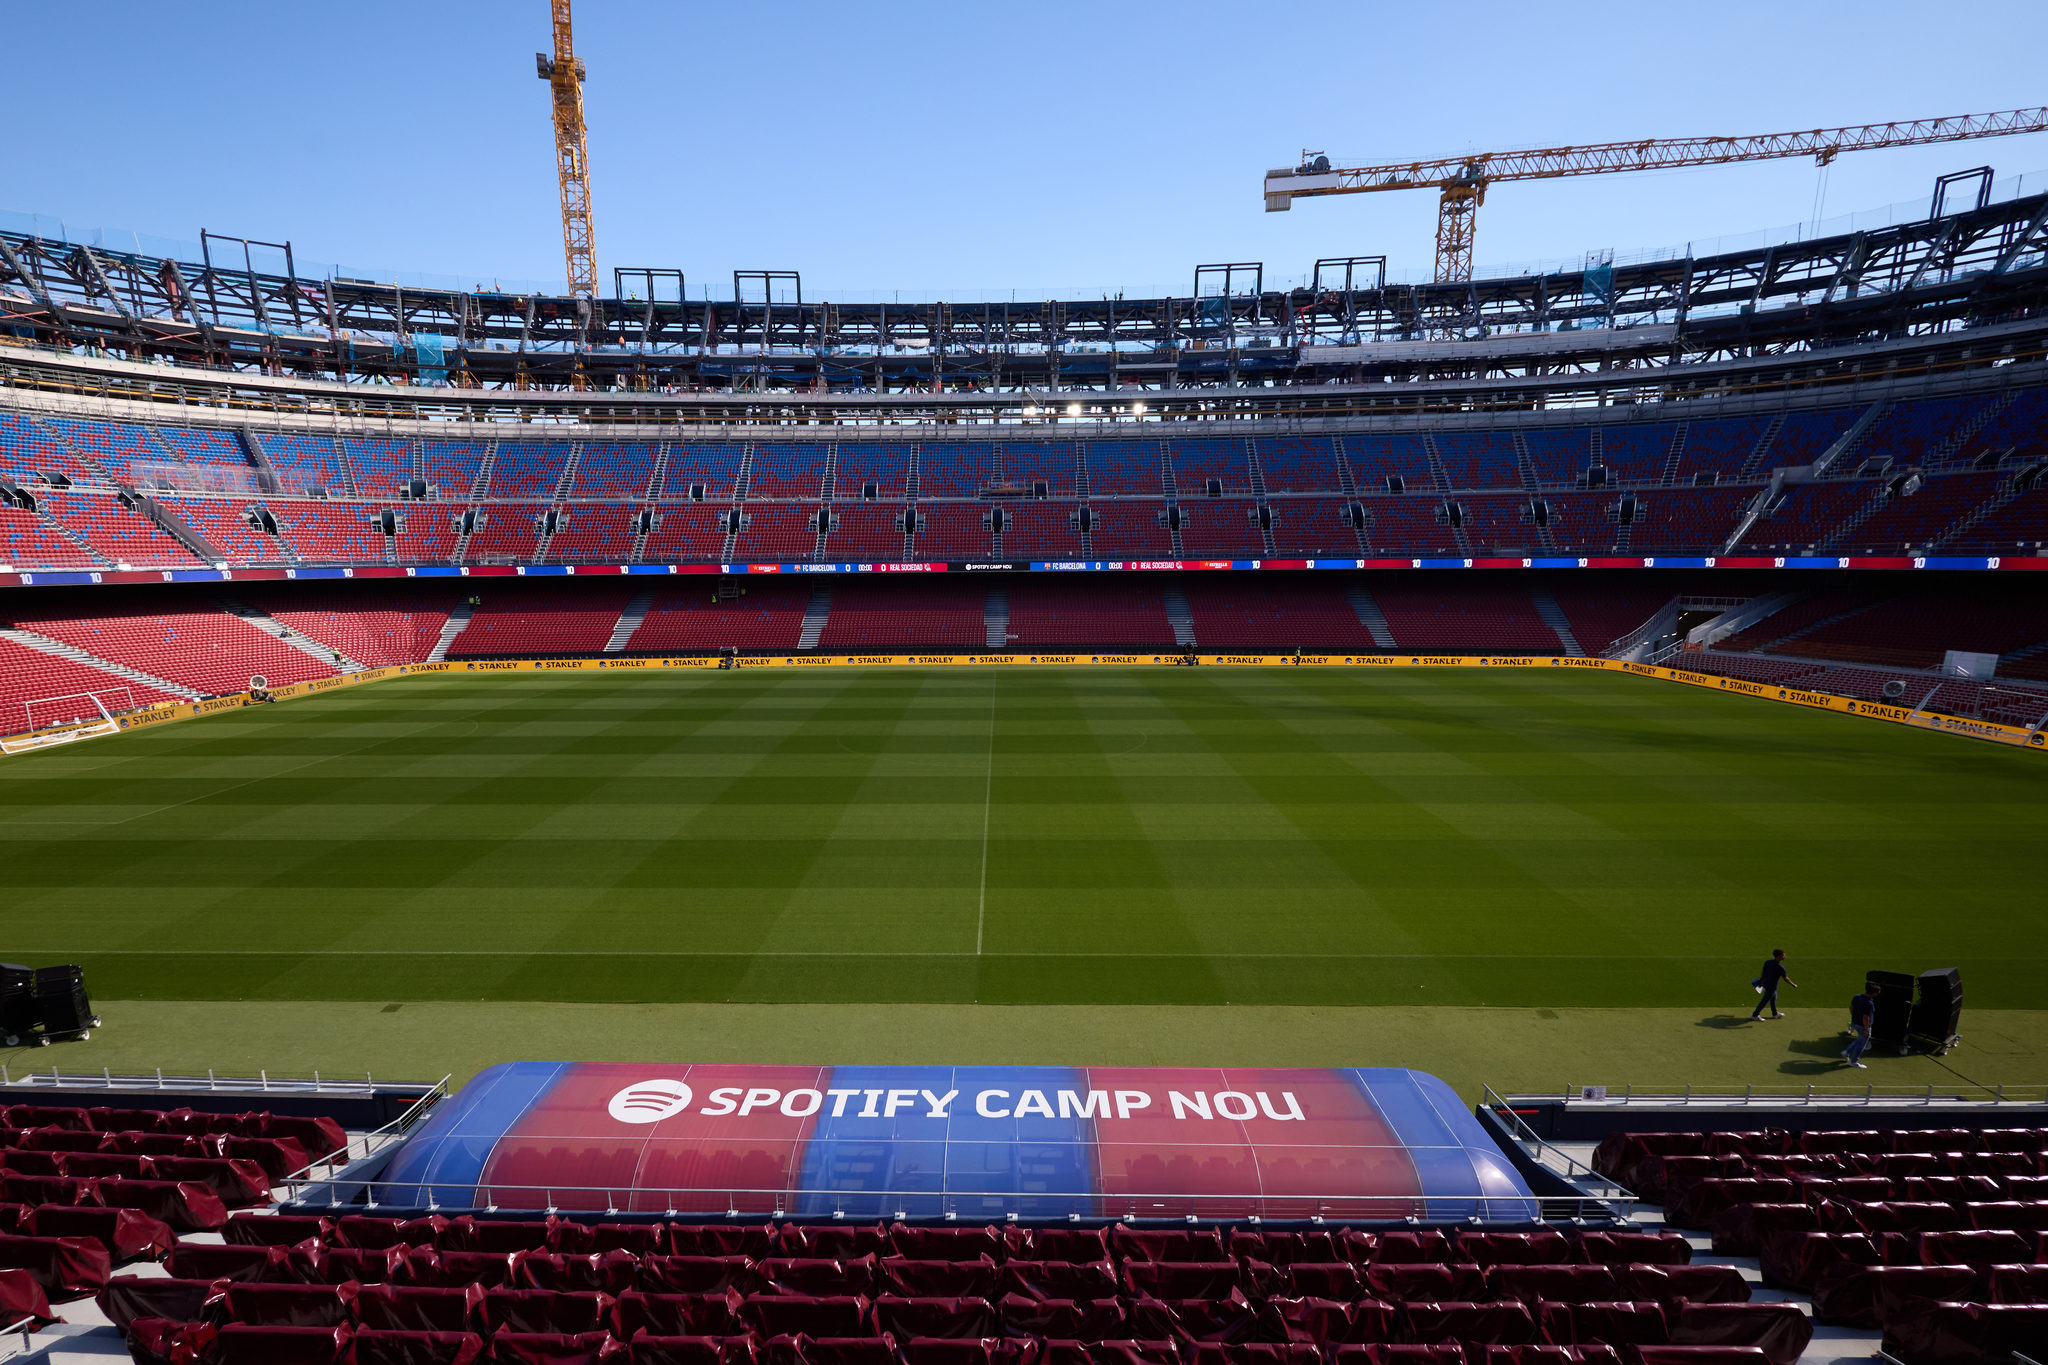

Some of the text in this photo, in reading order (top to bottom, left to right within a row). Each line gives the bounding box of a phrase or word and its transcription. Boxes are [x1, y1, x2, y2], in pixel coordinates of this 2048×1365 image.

[1252, 561, 1260, 569] 10
[1306, 560, 1314, 568] 10
[1356, 560, 1364, 568] 10
[1412, 559, 1421, 568] 10
[1464, 559, 1472, 567] 10
[1522, 559, 1531, 567] 10
[1578, 558, 1587, 567] 10
[1644, 558, 1654, 567] 10
[1705, 558, 1715, 567] 10
[1775, 558, 1784, 567] 10
[1839, 558, 1849, 567] 10
[1914, 558, 1925, 568] 10
[1987, 557, 1999, 569] 10
[343, 568, 353, 577] 10
[405, 568, 415, 576] 10
[460, 567, 469, 575] 10
[517, 567, 525, 575] 10
[566, 566, 574, 574] 10
[620, 566, 628, 574] 10
[669, 565, 677, 573] 10
[721, 565, 729, 573] 10
[846, 564, 851, 572] 0
[89, 573, 102, 583] 10
[162, 571, 172, 581] 10
[222, 571, 232, 579] 10
[286, 569, 297, 578] 10
[20, 574, 33, 584] 10
[410, 663, 449, 672] STANLEY
[479, 662, 517, 670] STANLEY
[546, 661, 582, 669] STANLEY
[1563, 659, 1605, 667] STANLEY
[1631, 664, 1656, 675] STANLEY
[361, 670, 385, 681] STANLEY
[1678, 672, 1707, 684] STANLEY
[316, 678, 343, 689] STANLEY
[1729, 680, 1764, 694] STANLEY
[1790, 692, 1831, 706] STANLEY
[204, 697, 240, 711] STANLEY
[1860, 703, 1910, 720] STANLEY
[133, 709, 175, 725] STANLEY
[700, 1087, 1306, 1120] SPOTIFY CAMP NOU
